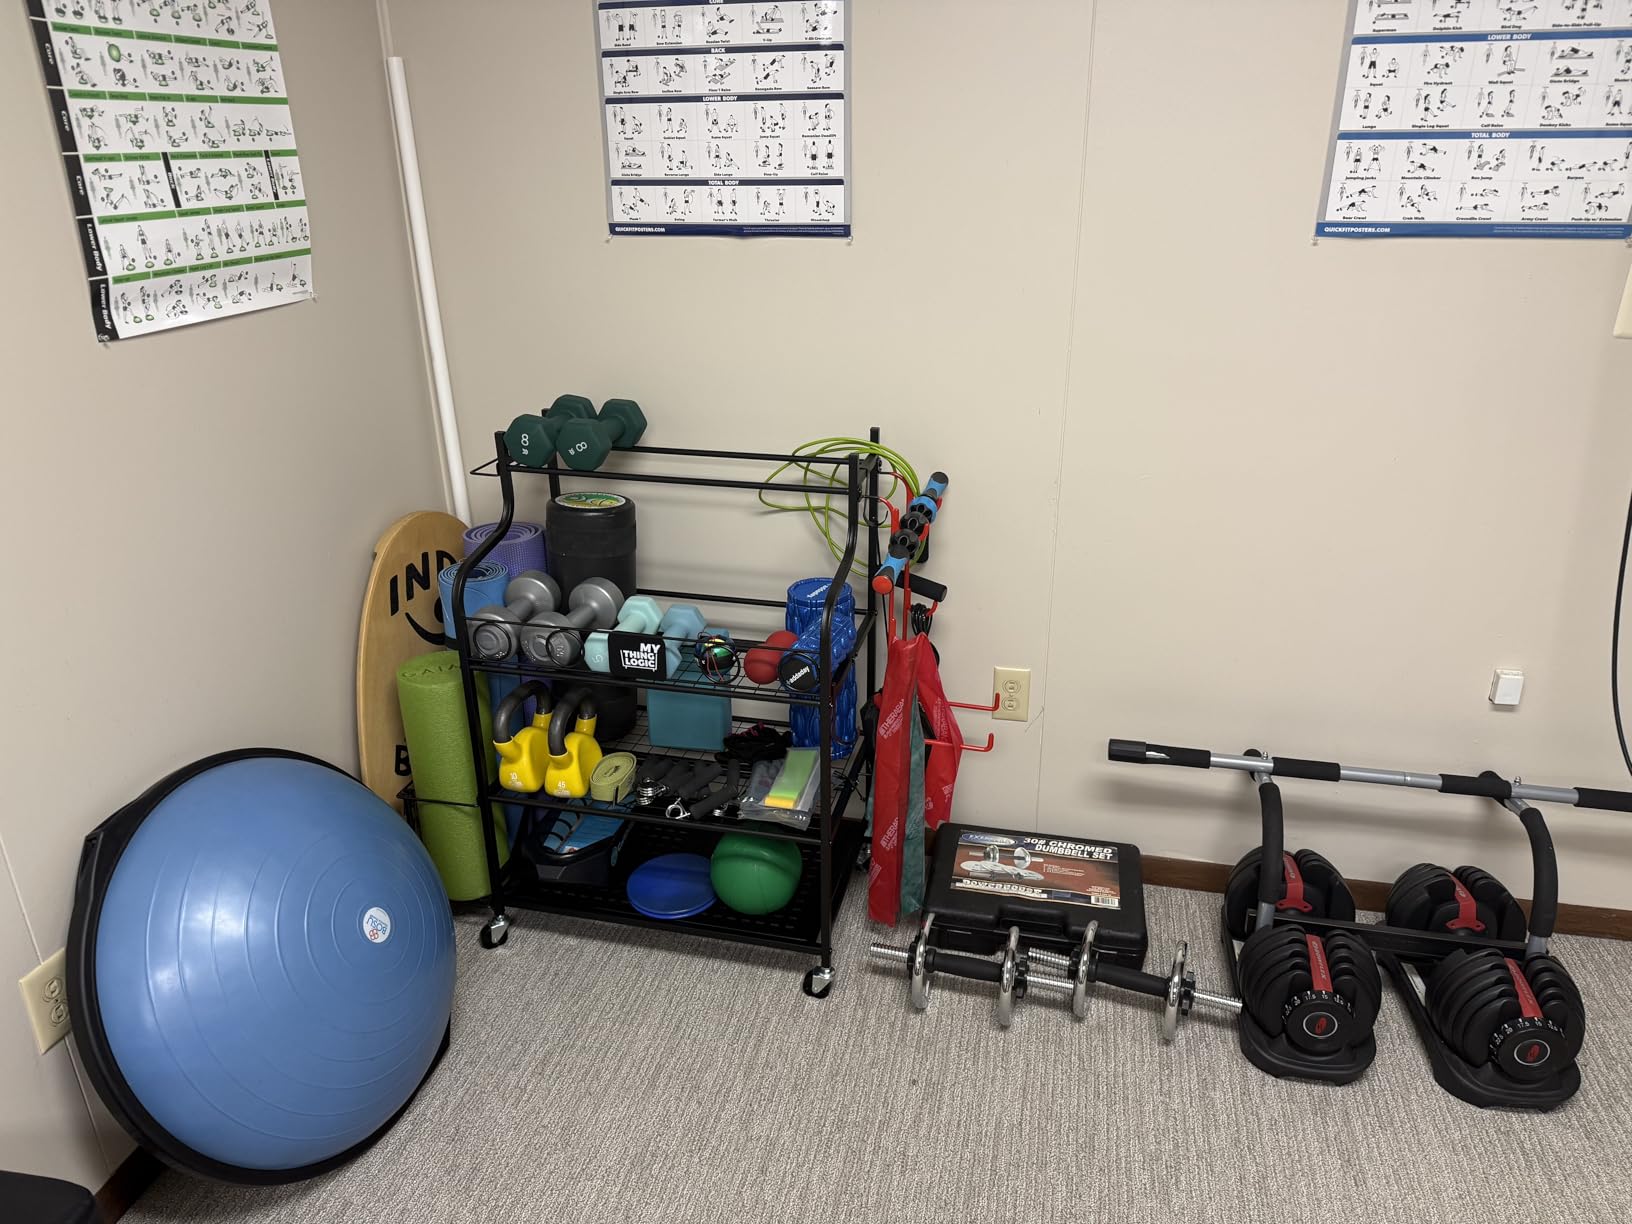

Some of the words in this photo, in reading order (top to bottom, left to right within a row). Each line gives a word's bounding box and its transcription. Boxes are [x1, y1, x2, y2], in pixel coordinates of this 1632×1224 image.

[45, 43, 54, 65] Core
[61, 110, 70, 132] Core
[76, 175, 85, 196] Core
[86, 223, 98, 250] Lower
[93, 250, 103, 272] Body
[102, 309, 113, 330] Body
[521, 433, 529, 447] 8
[575, 441, 588, 452] 8
[389, 549, 456, 617] IND
[623, 650, 655, 661] THING
[640, 643, 661, 653] MY
[624, 657, 655, 668] LOGIC
[1023, 837, 1046, 846] 30#
[1049, 841, 1114, 855] CHROMED
[1035, 844, 1089, 858] DUMBBELL
[1091, 851, 1113, 860] SET
[366, 915, 388, 935] BOSU
